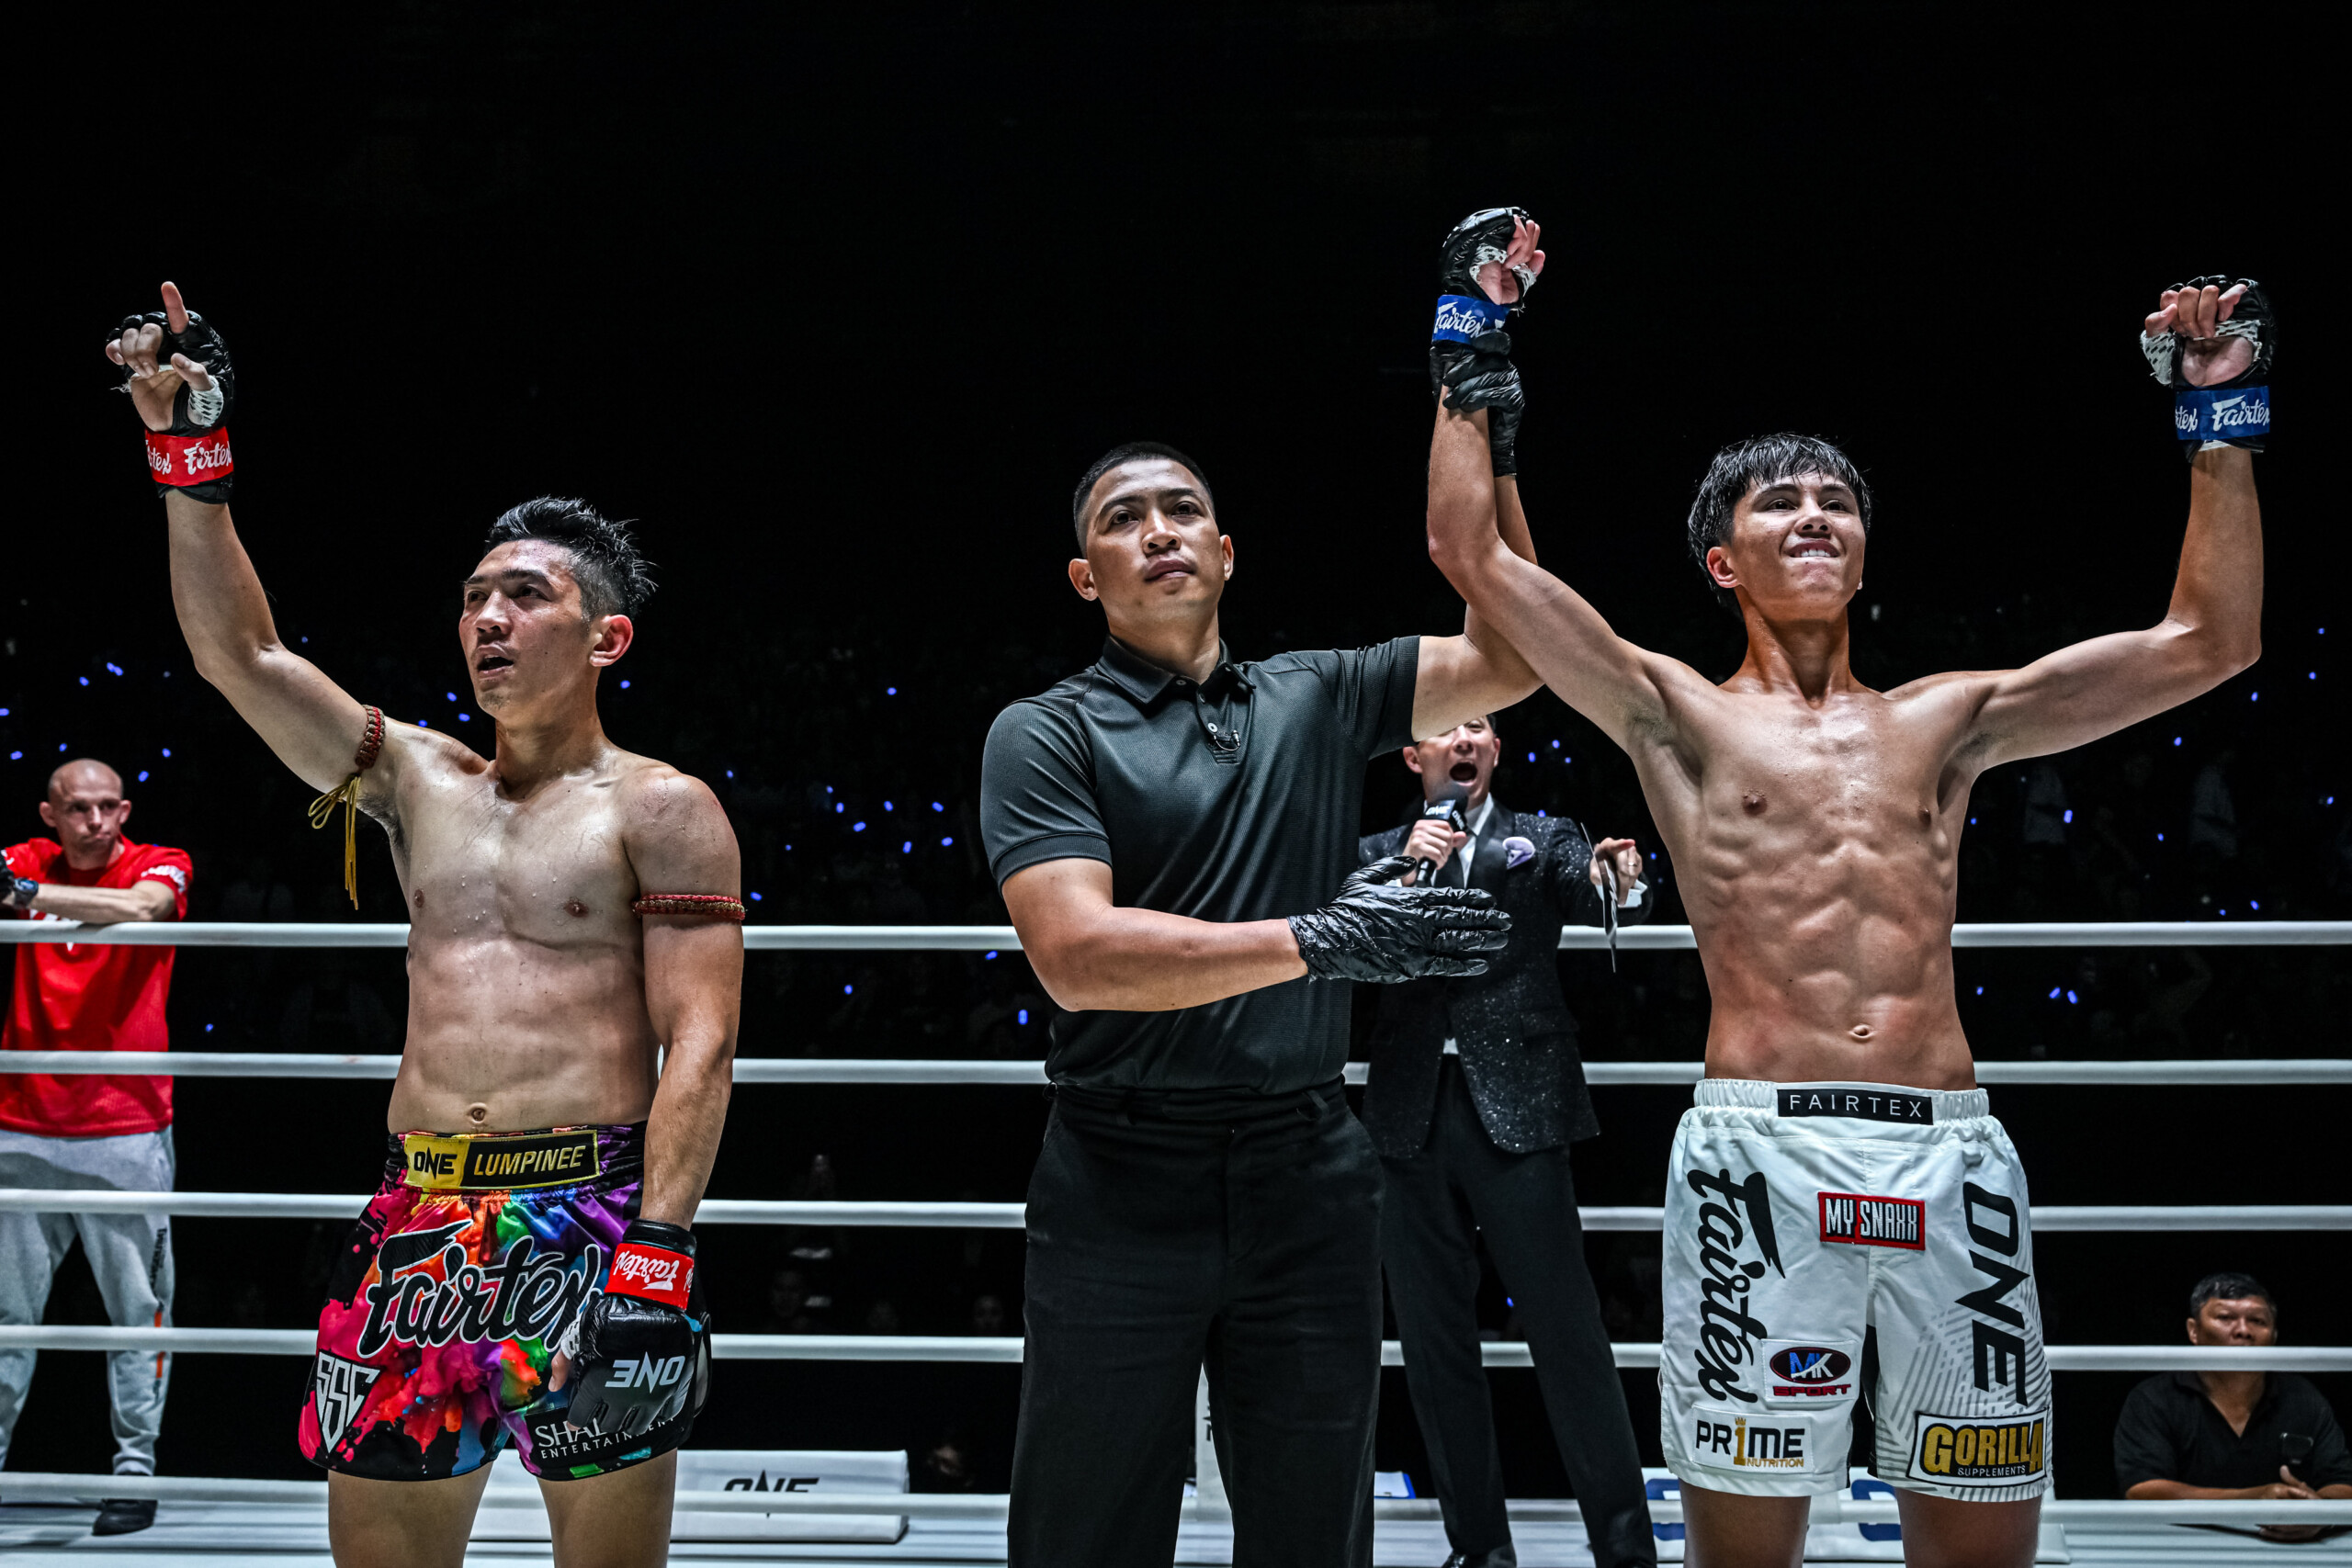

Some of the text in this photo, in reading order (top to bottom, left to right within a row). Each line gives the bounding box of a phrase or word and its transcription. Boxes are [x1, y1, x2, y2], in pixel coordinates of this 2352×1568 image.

[2211, 394, 2270, 432] Fairtex
[1789, 1094, 1922, 1118] FAIRTEX
[413, 1145, 586, 1179] ONE LUMPINEE
[1826, 1198, 1854, 1237] MY
[356, 1219, 603, 1358] Fairtex
[613, 1250, 680, 1292] Fairtex
[1687, 1168, 1785, 1404] Fairtex
[1954, 1181, 2031, 1407] ONE
[605, 1351, 685, 1393] ONE
[1773, 1383, 1852, 1396] SPORT
[1747, 1459, 1804, 1468] NUTRITION
[1922, 1420, 2043, 1473] GORILLA
[1957, 1465, 2026, 1477] SUPPLEMENTS
